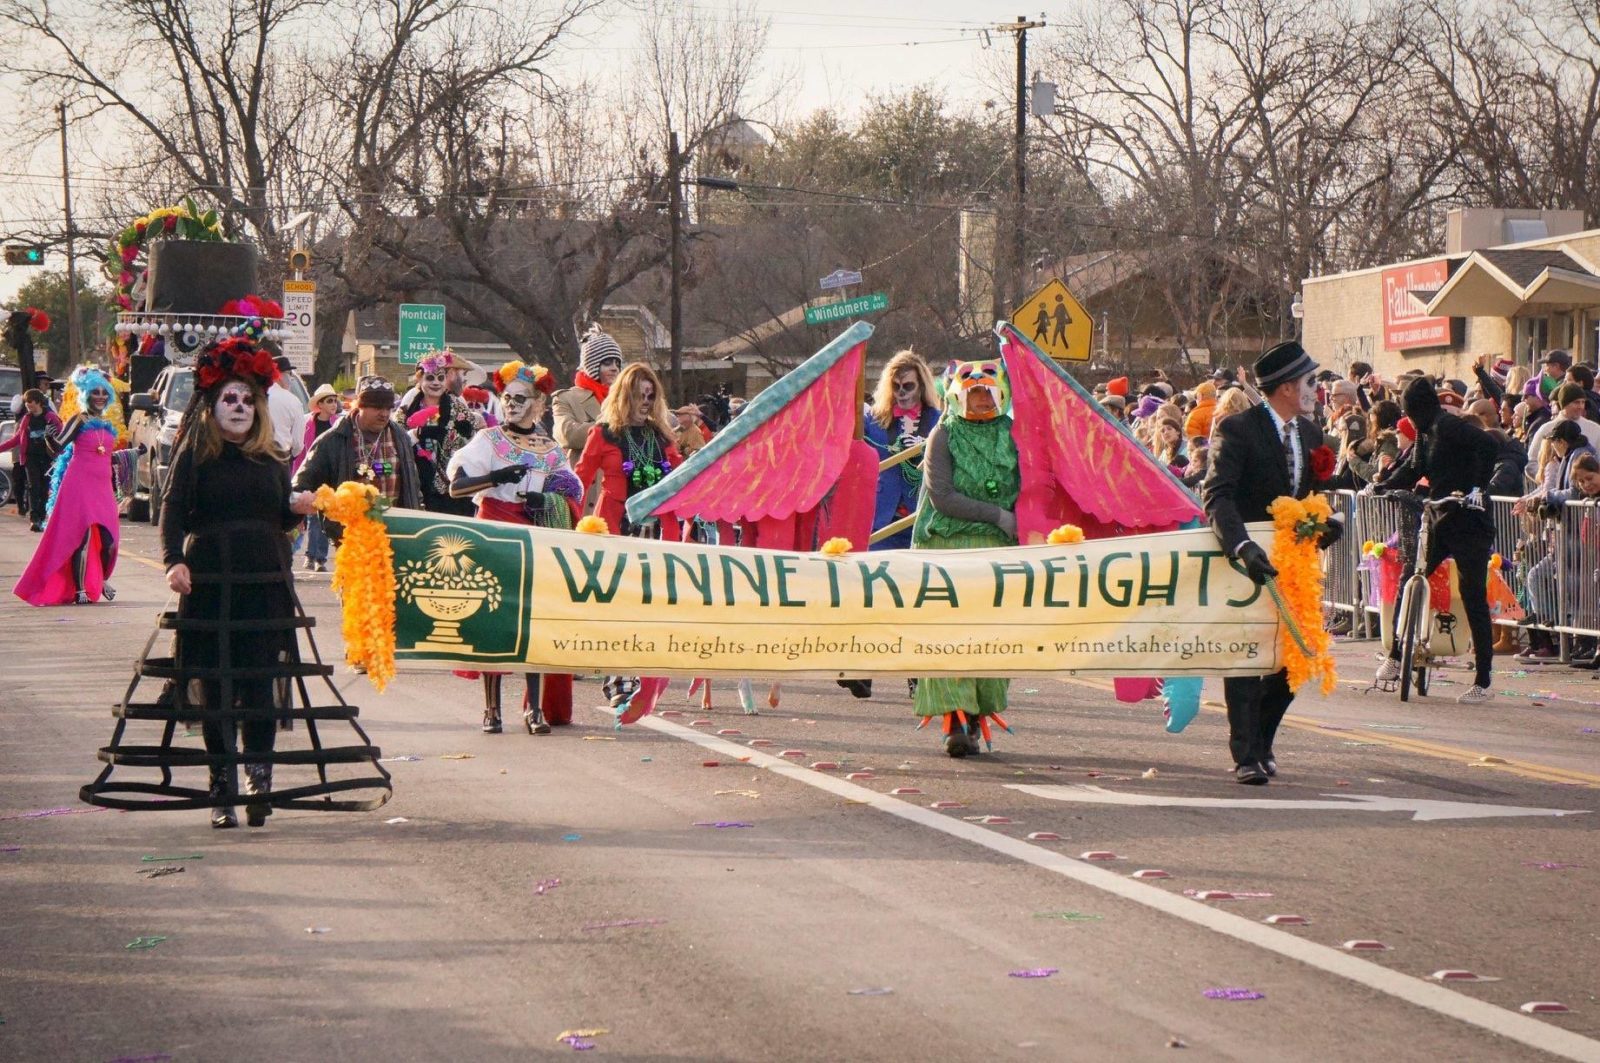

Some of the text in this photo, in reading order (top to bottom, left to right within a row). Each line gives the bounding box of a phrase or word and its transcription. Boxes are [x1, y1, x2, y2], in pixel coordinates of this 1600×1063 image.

[285, 282, 313, 291] SCHOOL
[401, 310, 443, 320] Montclair
[814, 300, 869, 320] Windomere
[286, 312, 311, 327] 20
[416, 323, 429, 333] Av
[409, 342, 434, 351] NEXT
[552, 633, 1260, 661] winnetka heights neighborhood association winnetkaheights.org
